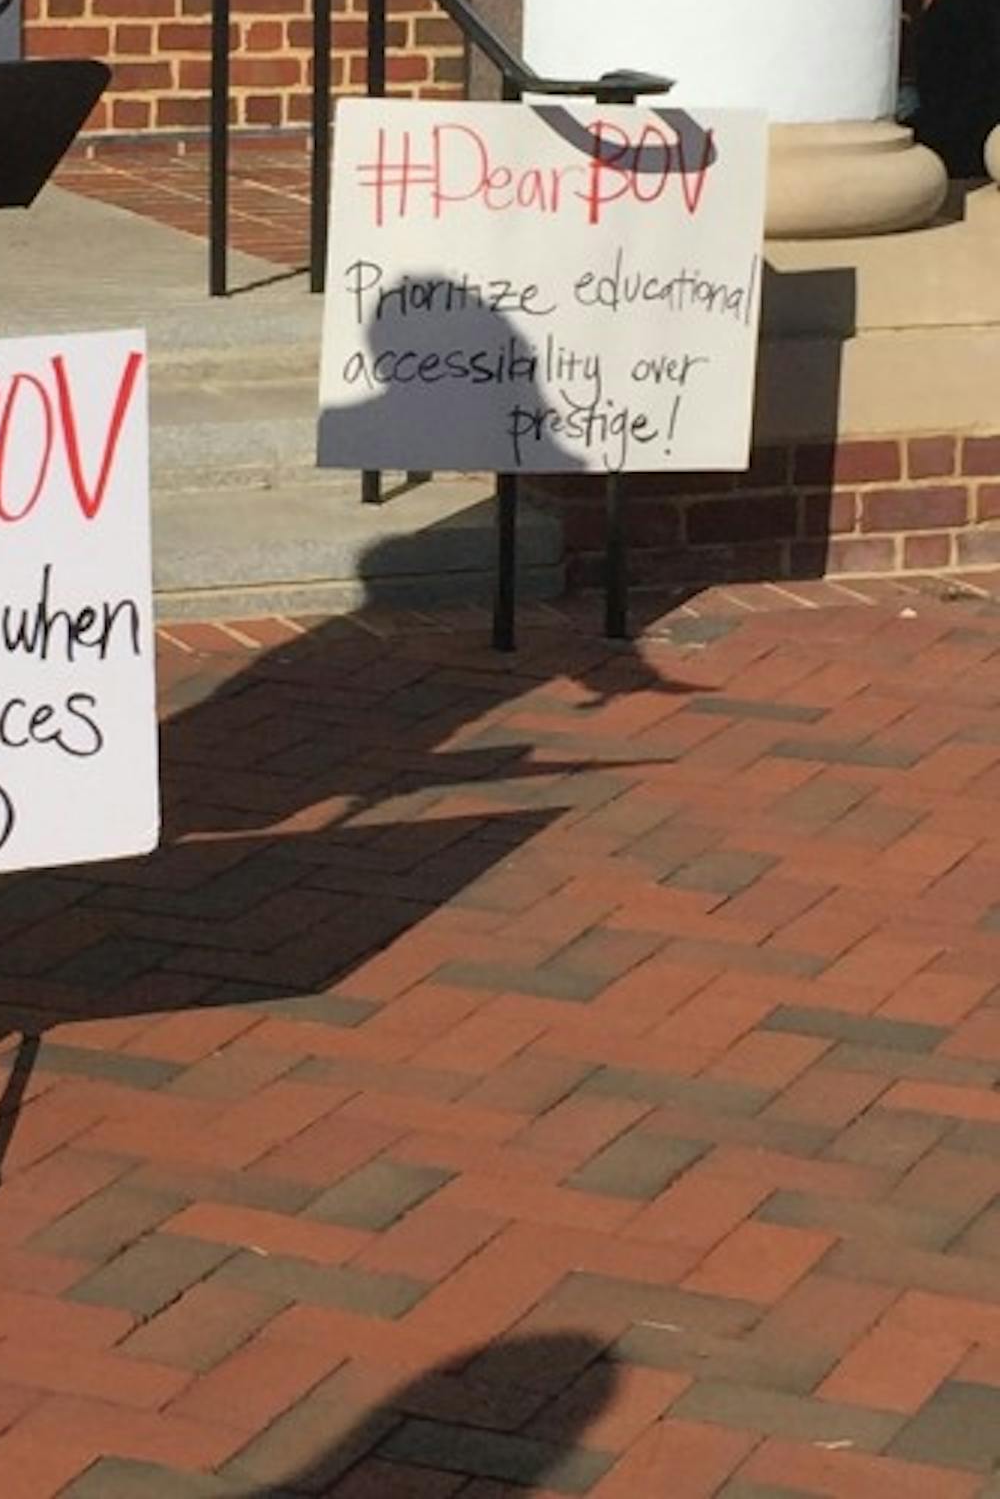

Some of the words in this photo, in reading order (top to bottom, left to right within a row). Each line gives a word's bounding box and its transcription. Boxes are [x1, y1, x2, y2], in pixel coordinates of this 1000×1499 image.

[357, 120, 714, 227] #DearBOV
[344, 260, 557, 324] Prioritize
[574, 247, 759, 324] educational
[343, 334, 602, 410] accessibility
[631, 354, 710, 386] over
[507, 396, 681, 472] prestige!
[2, 564, 141, 662] when
